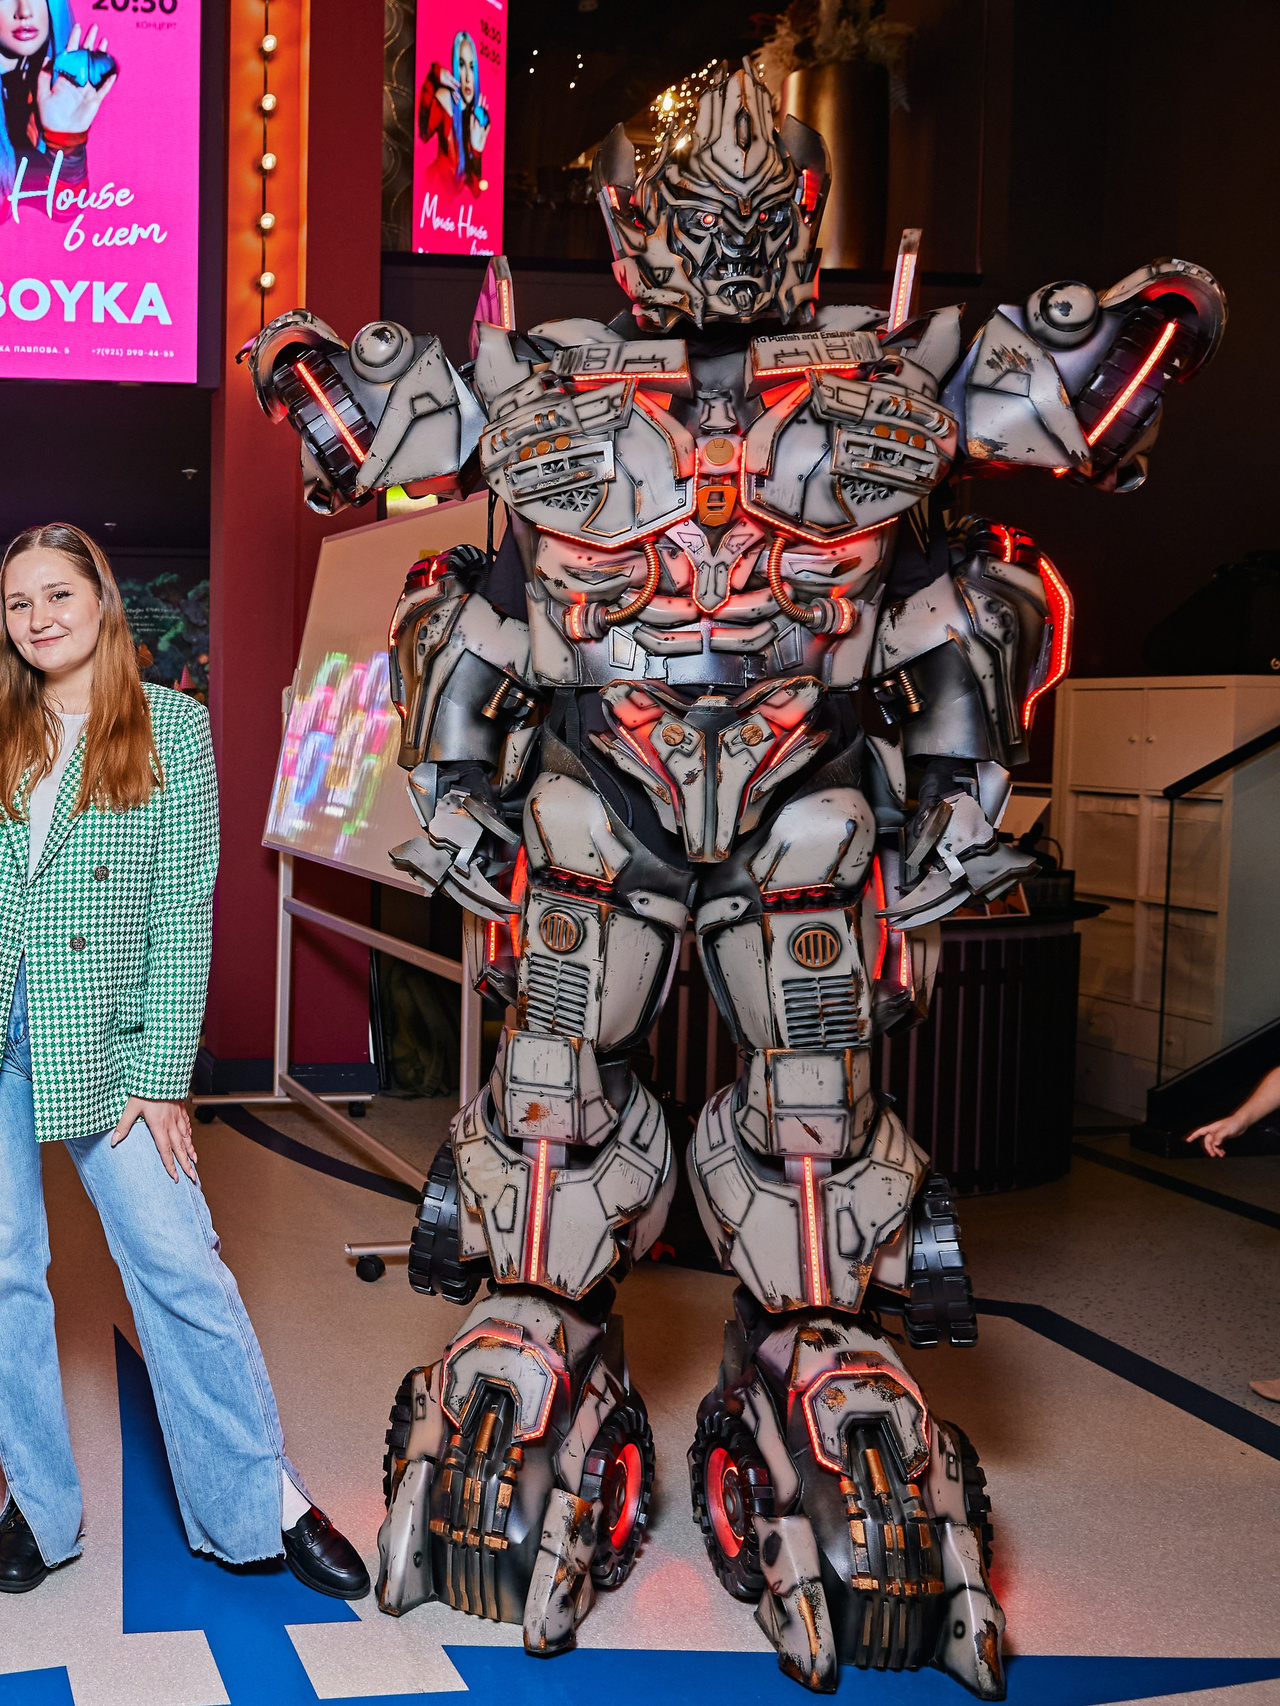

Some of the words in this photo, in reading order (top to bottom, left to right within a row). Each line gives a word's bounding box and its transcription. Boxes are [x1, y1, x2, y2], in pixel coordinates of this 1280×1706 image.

[7, 150, 134, 224] House
[420, 192, 455, 232] Mouse
[92, 223, 167, 248] лет
